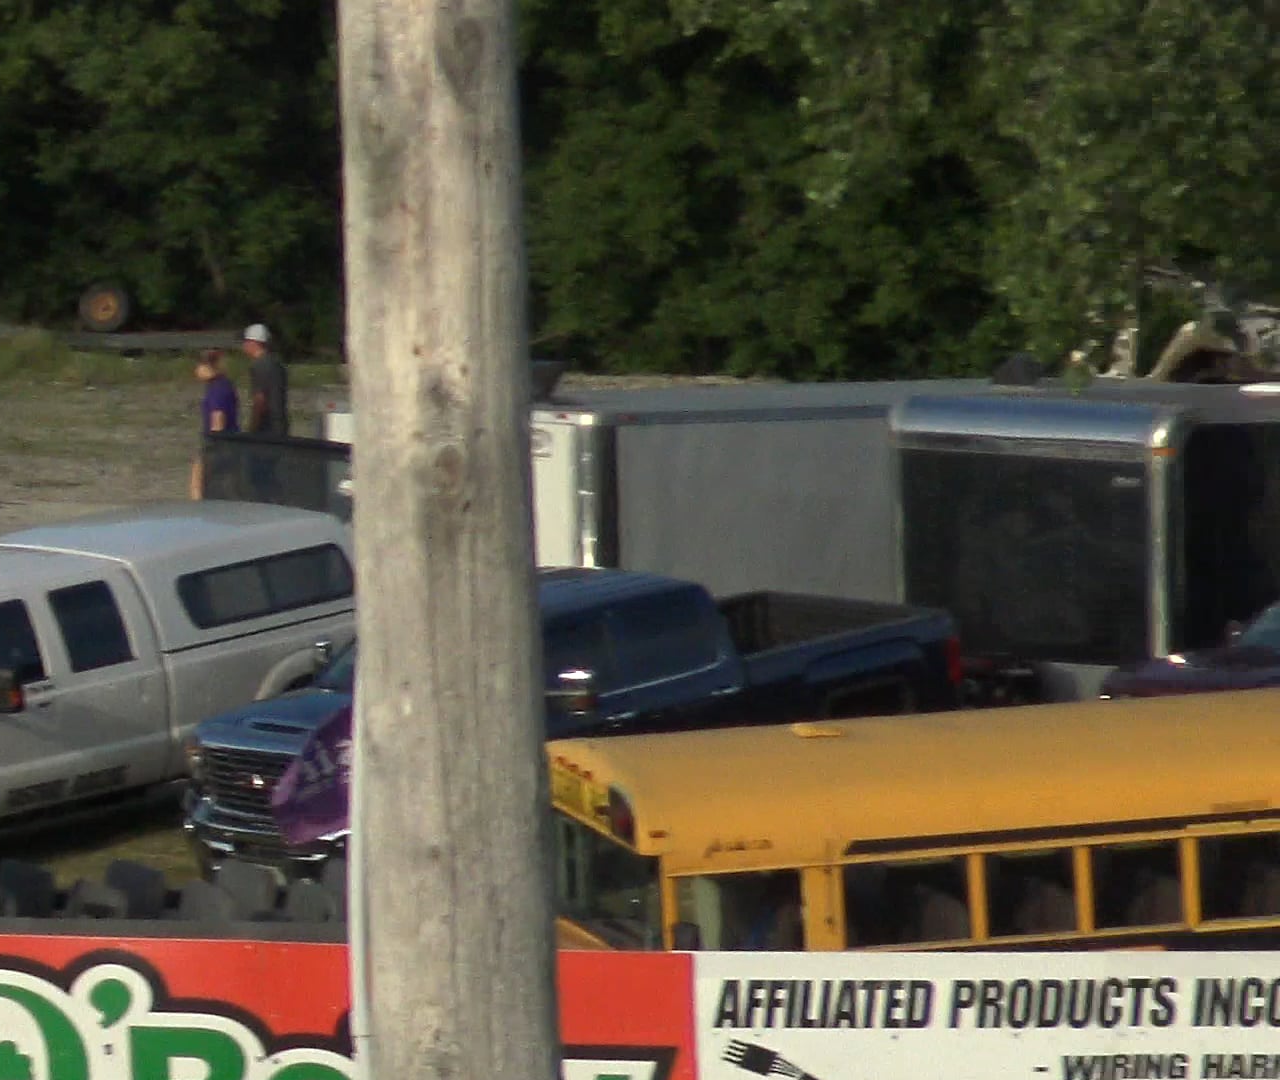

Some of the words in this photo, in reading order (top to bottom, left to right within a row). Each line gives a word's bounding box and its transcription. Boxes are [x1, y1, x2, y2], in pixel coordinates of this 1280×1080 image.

[713, 978, 936, 1030] AFFILIATED
[946, 977, 1178, 1029] PRODUCTS
[1060, 1053, 1190, 1080] WIRING
